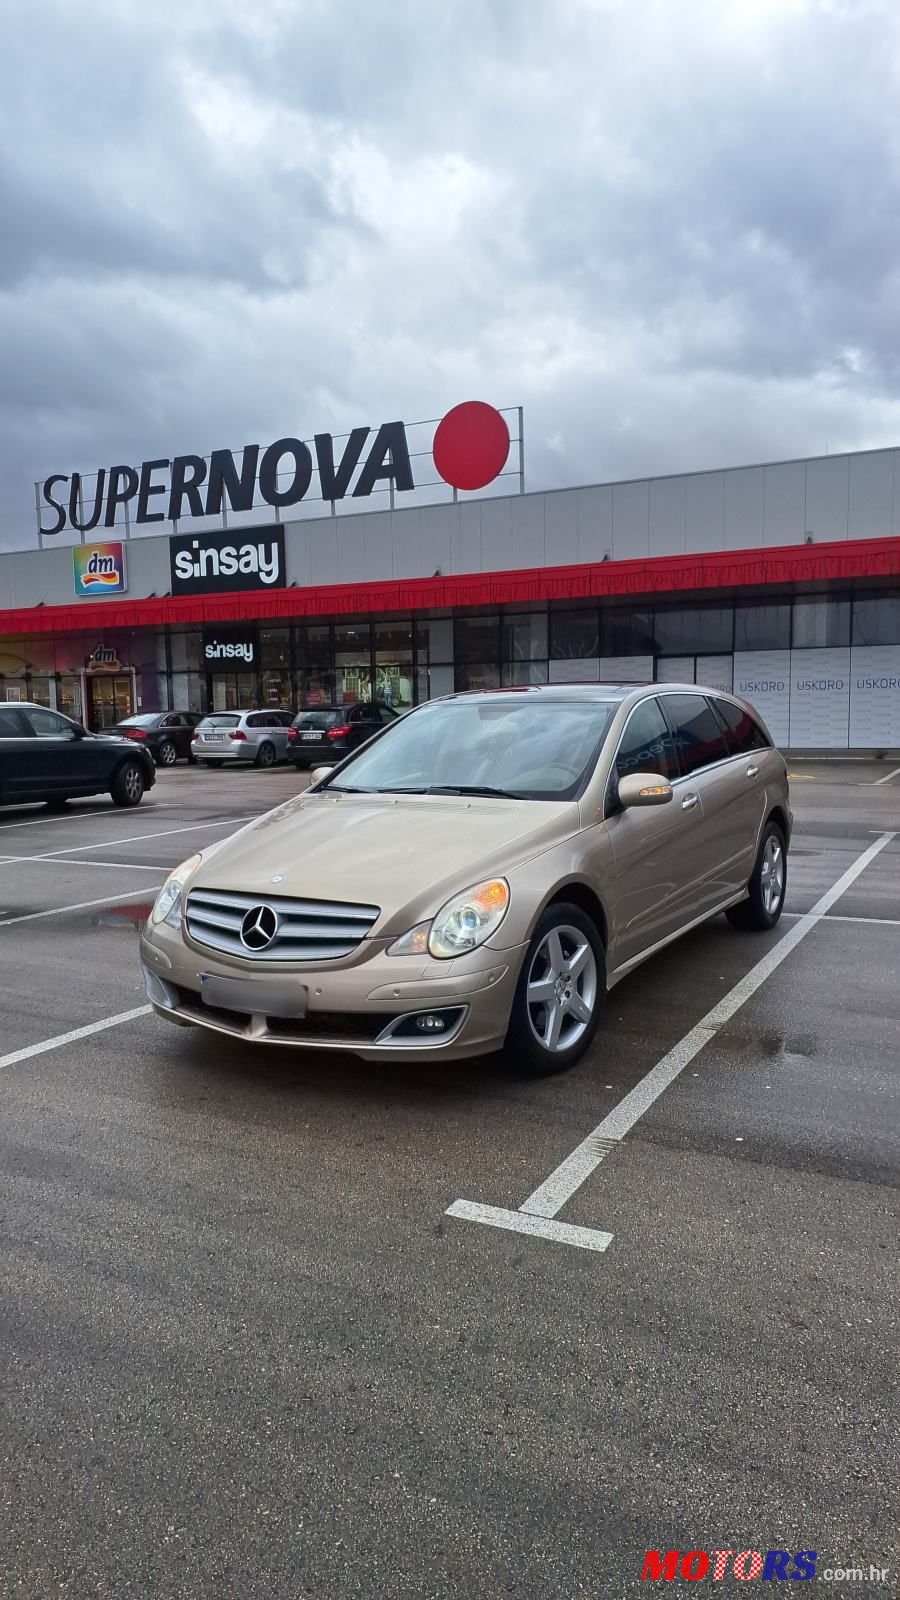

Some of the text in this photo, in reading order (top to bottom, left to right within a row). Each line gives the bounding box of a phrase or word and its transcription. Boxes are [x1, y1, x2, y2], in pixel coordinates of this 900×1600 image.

[39, 421, 415, 535] SUPERNOVA
[87, 552, 115, 574] dm
[175, 540, 280, 584] sinsay
[94, 644, 117, 662] dm
[205, 640, 254, 662] sinsay
[740, 681, 785, 692] USKORO
[796, 679, 844, 691] USKORO
[856, 678, 900, 689] USKOR
